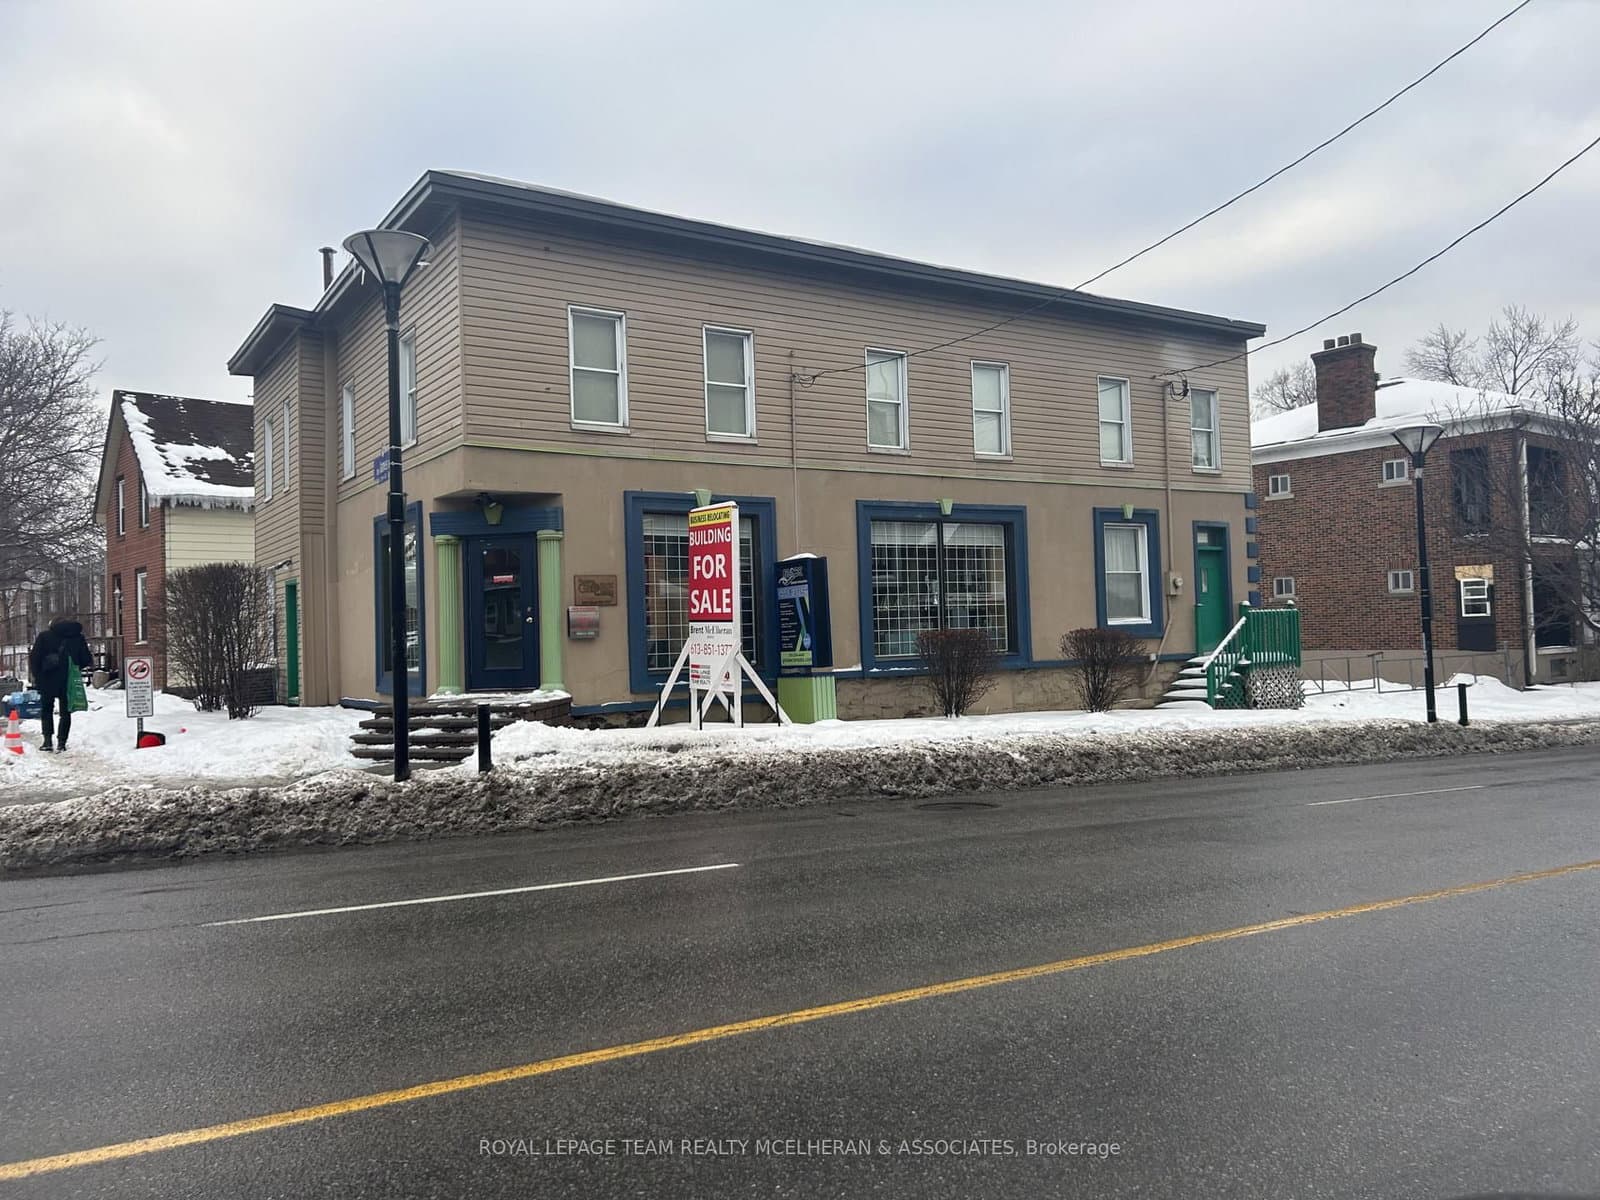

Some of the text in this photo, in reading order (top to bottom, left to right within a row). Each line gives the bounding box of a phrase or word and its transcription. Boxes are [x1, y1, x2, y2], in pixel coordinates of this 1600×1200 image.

[690, 510, 730, 524] BUSINESS RELOCATING
[689, 526, 731, 546] BUILDING
[693, 553, 727, 580] FOR
[690, 588, 732, 614] SALE
[690, 625, 704, 634] Brent
